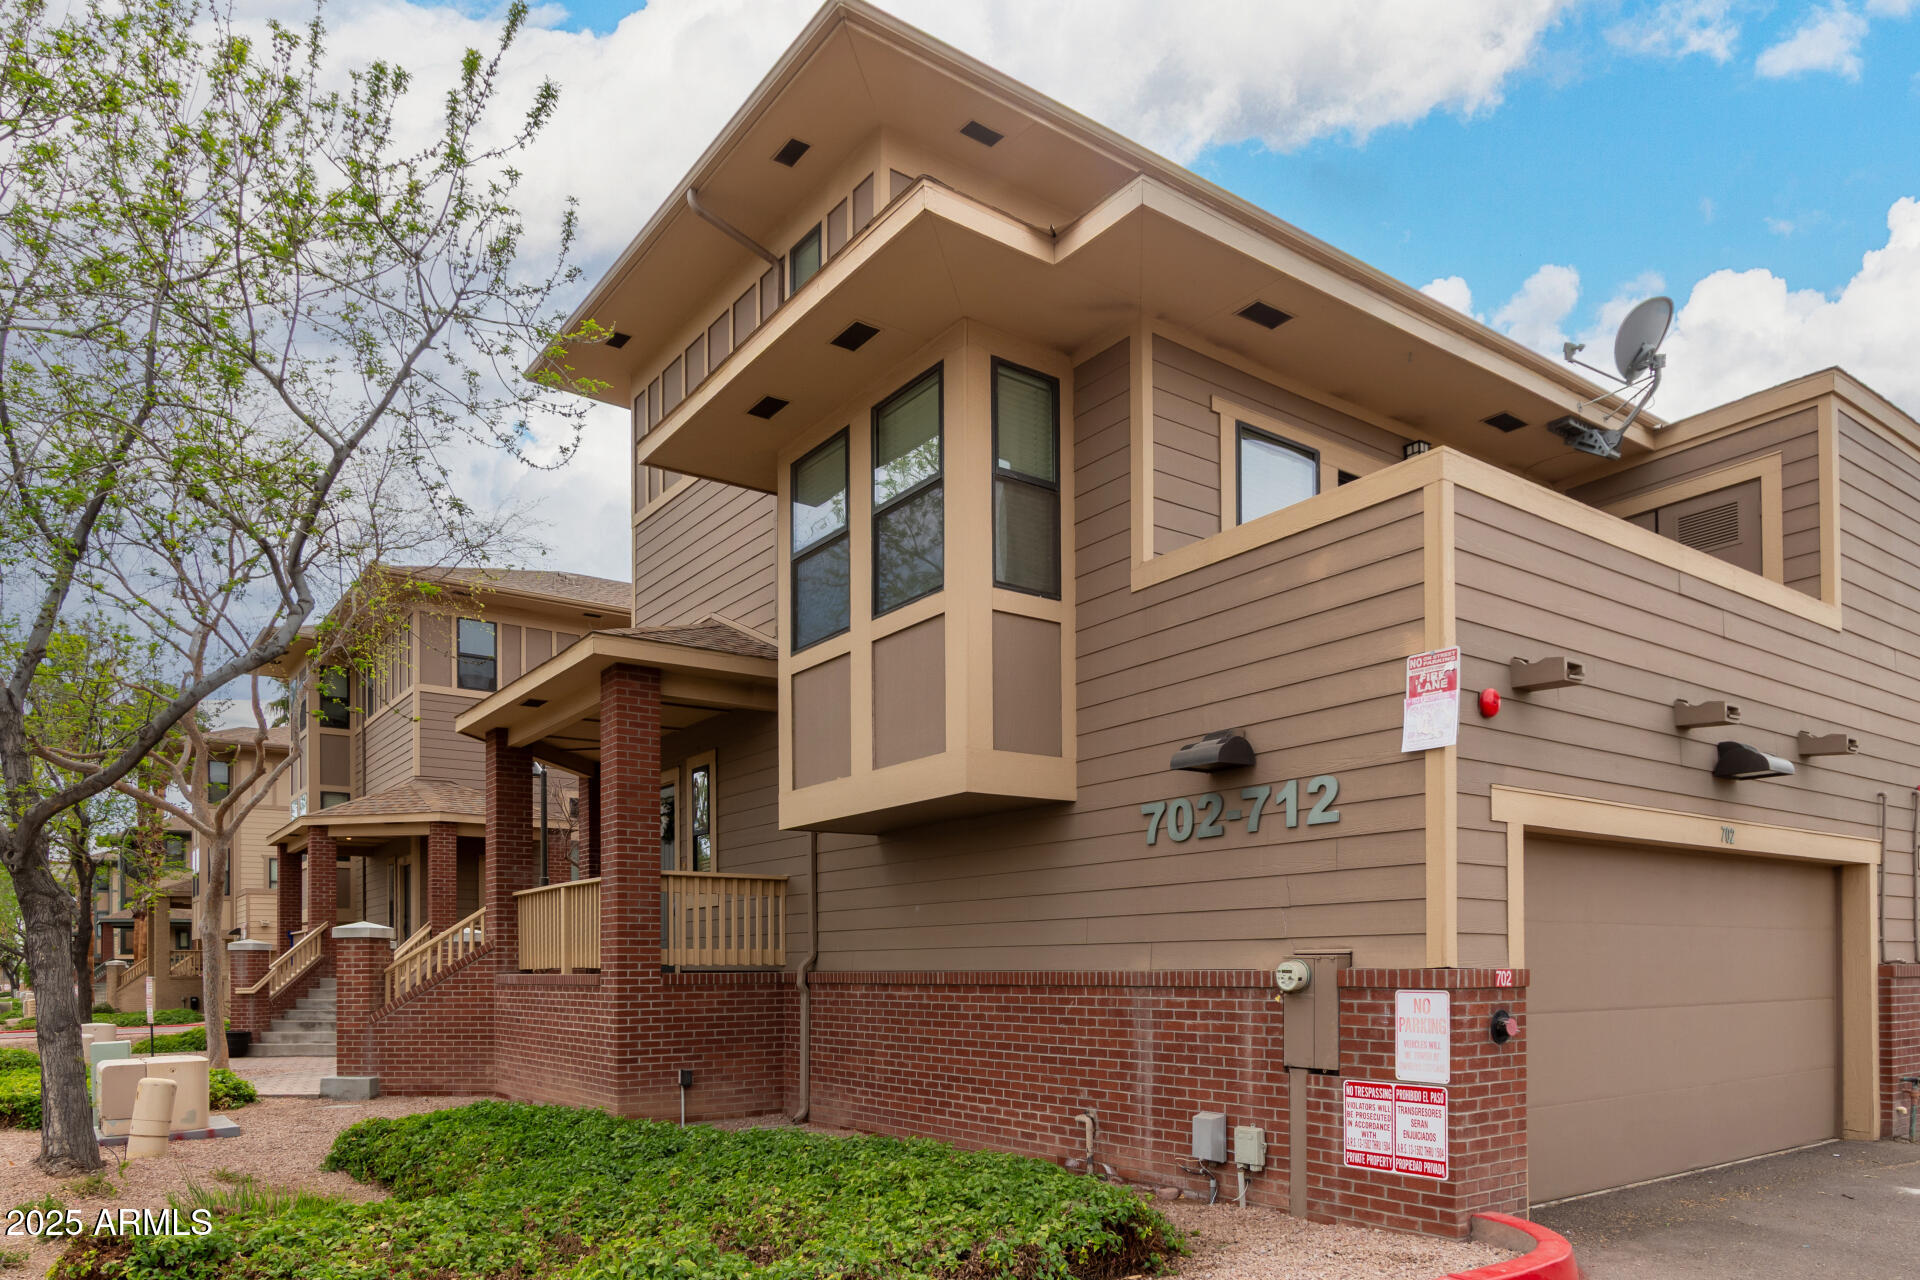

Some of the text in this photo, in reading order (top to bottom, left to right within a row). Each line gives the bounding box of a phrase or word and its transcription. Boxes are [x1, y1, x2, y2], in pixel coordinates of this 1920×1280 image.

[1409, 657, 1423, 669] NO
[1419, 670, 1445, 682] FIRE
[1417, 679, 1448, 692] LANE
[1140, 775, 1340, 845] 702-712
[1720, 826, 1735, 844] 702
[1496, 970, 1512, 987] 702
[1413, 998, 1431, 1015] NO
[1399, 1016, 1447, 1035] PARKING
[1346, 1085, 1392, 1100] NO TRESPASSING
[1396, 1088, 1445, 1104] PROHIBIDO EL PASO
[1347, 1101, 1391, 1112] VIOLATORS WILL
[1397, 1105, 1442, 1119] TRANSGRESORES
[1355, 1112, 1392, 1122] PROSECUTED
[1410, 1119, 1429, 1129] SERAN
[1354, 1120, 1391, 1132] ACCORDANCE
[1361, 1131, 1377, 1139] WITH
[1403, 1130, 1437, 1142] ENJUICIADOS
[1346, 1151, 1392, 1168] PRIVATE PROPERTY
[1396, 1157, 1446, 1177] PROPIEDAD PRIVADA
